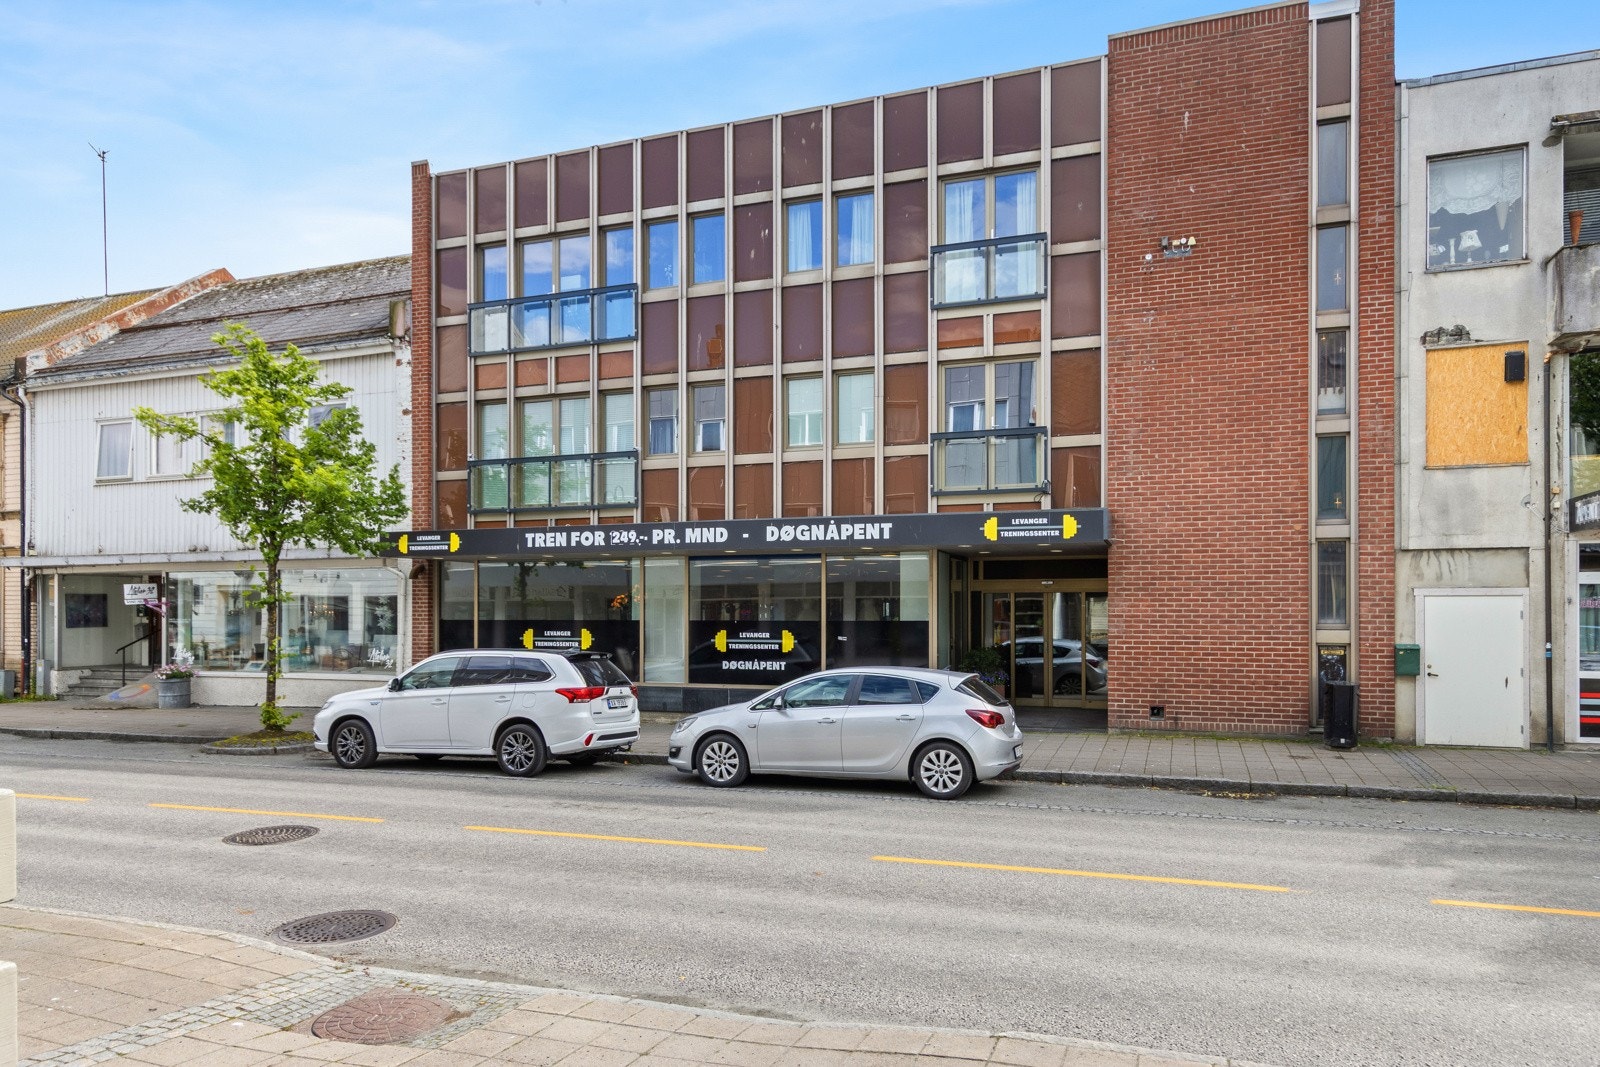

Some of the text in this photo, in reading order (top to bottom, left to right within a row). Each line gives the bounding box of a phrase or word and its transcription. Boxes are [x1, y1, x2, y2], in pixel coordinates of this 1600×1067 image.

[525, 532, 567, 548] TREN
[570, 531, 606, 547] FOR
[652, 529, 681, 544] PR.
[685, 527, 729, 543] MND
[766, 520, 893, 542] DØGNÅPENT
[722, 658, 787, 671] DØGNÅPENT
